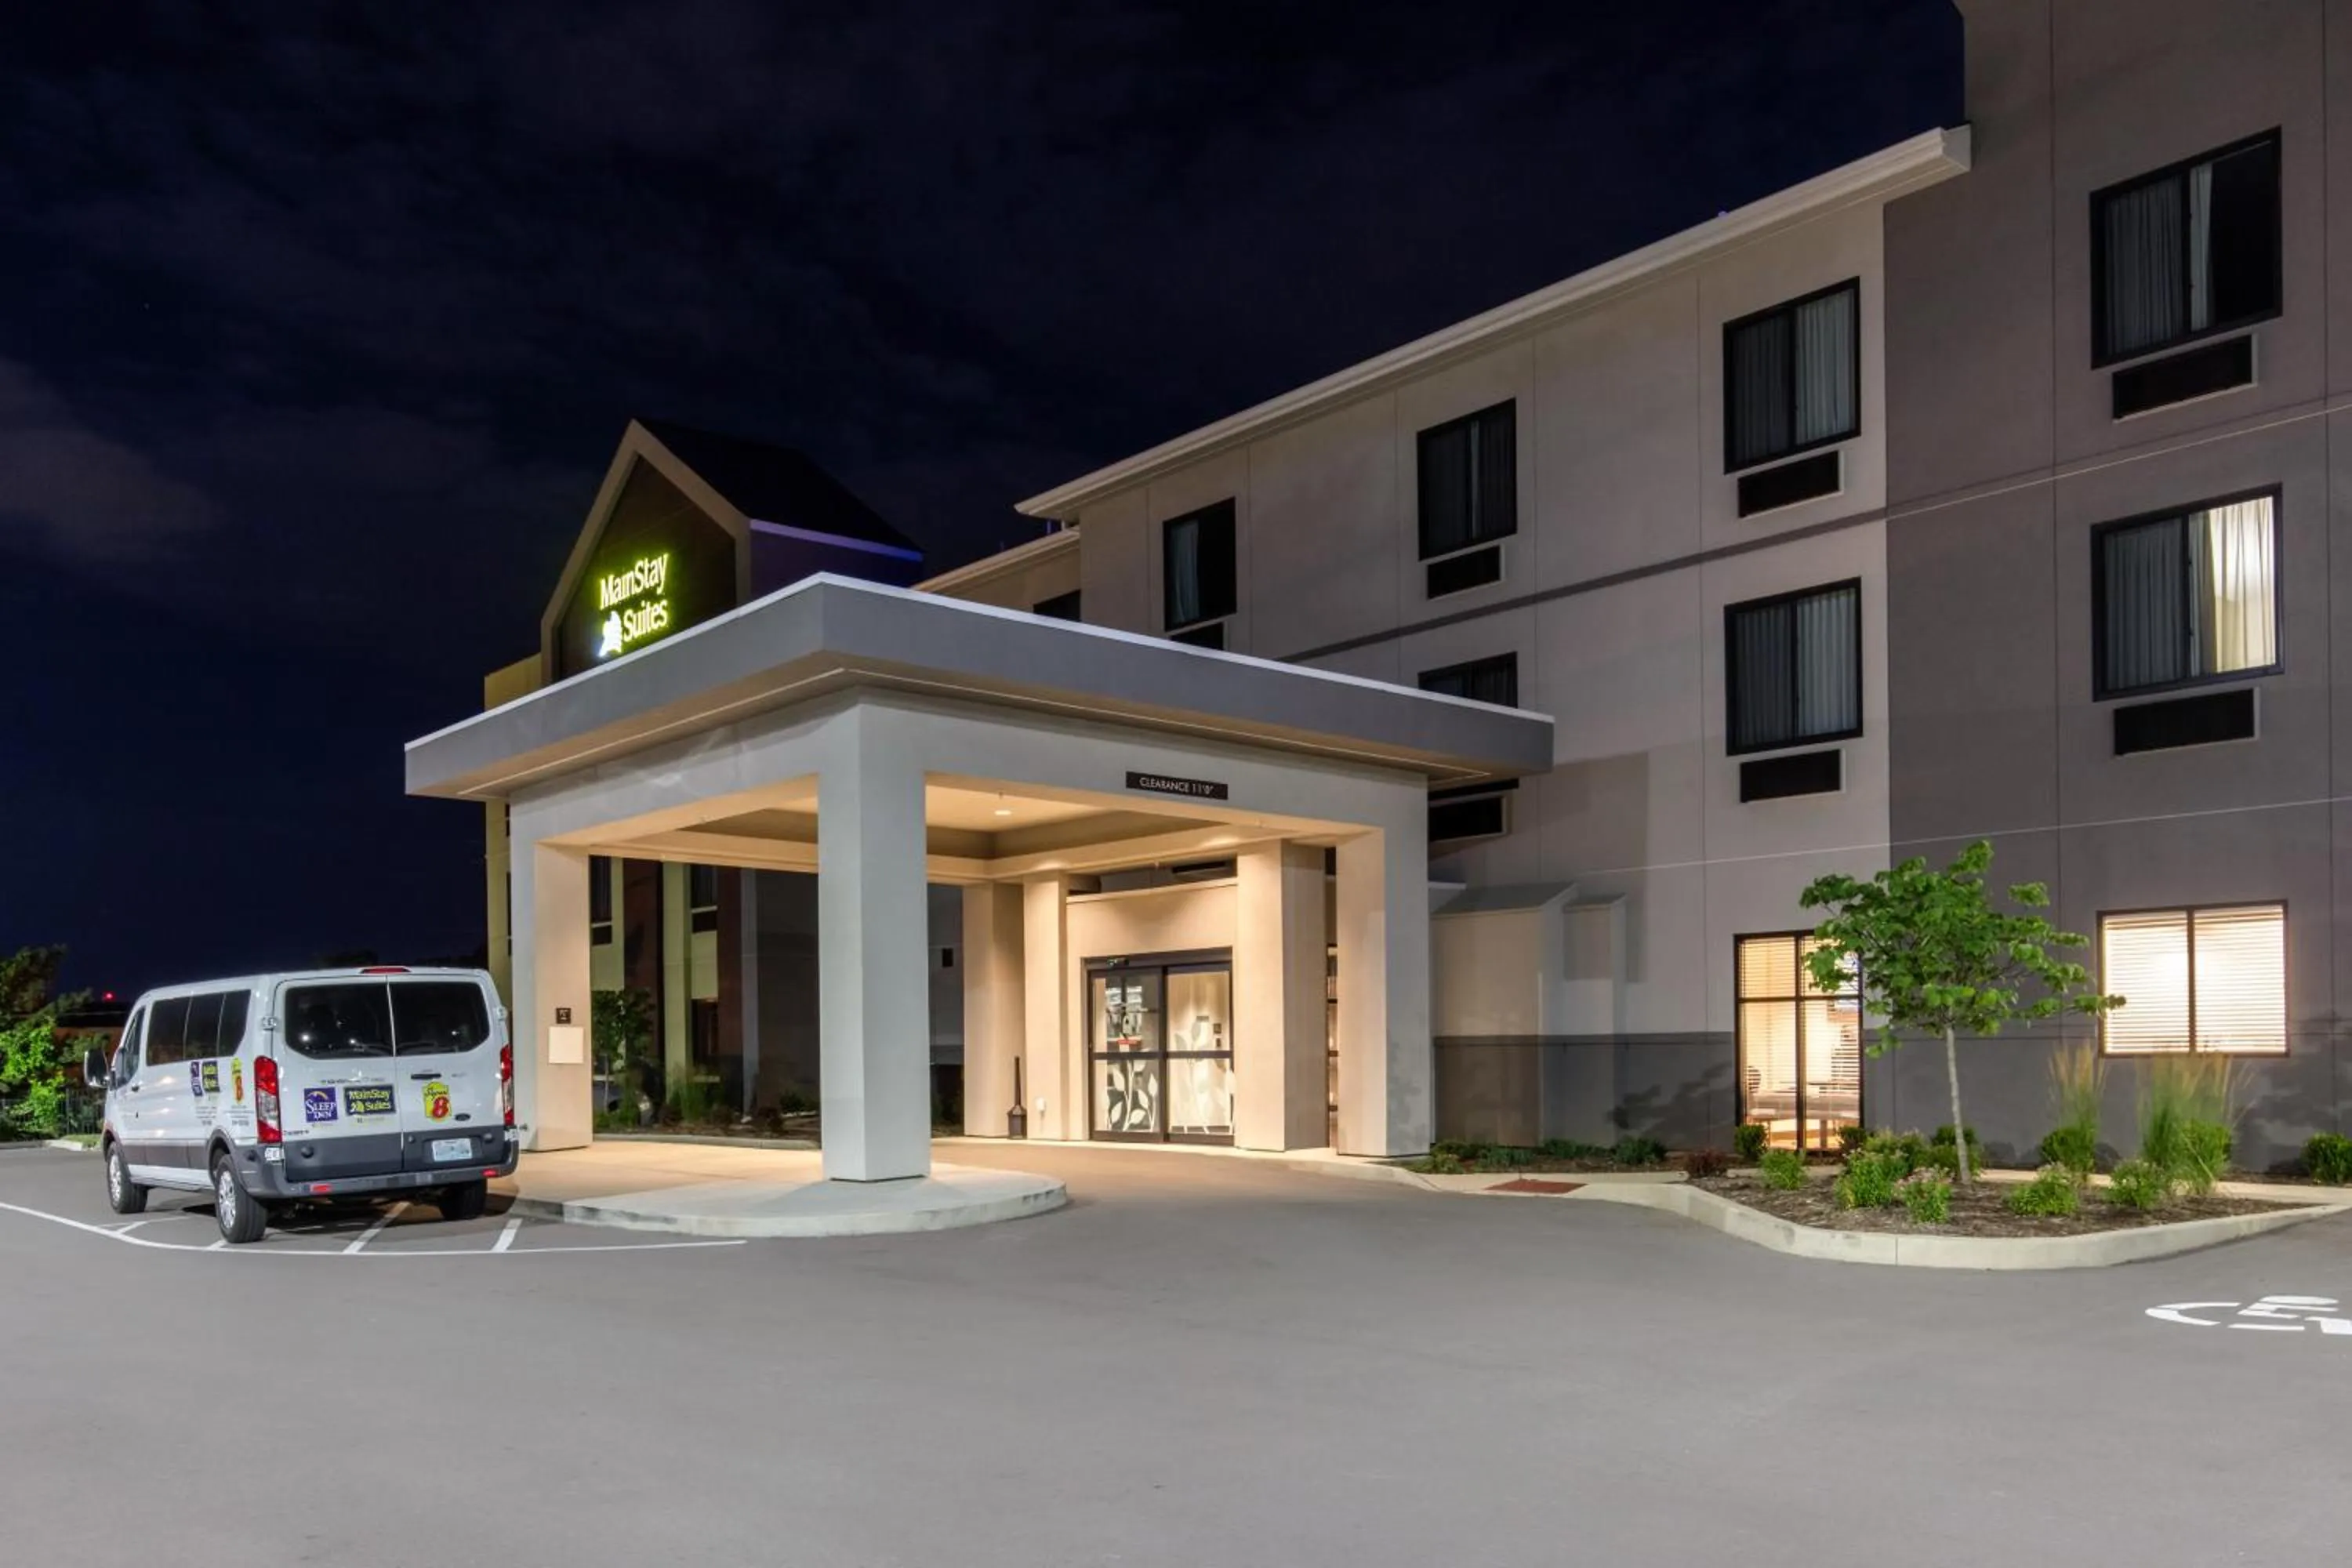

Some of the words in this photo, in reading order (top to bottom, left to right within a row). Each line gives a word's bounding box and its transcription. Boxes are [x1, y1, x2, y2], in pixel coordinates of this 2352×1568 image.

[600, 553, 669, 611] MainStay
[623, 599, 668, 642] Suites
[1139, 777, 1189, 793] CLEARANCE
[350, 1090, 390, 1100] MainStay
[306, 1099, 336, 1113] SLEEP
[365, 1101, 390, 1111] Suites
